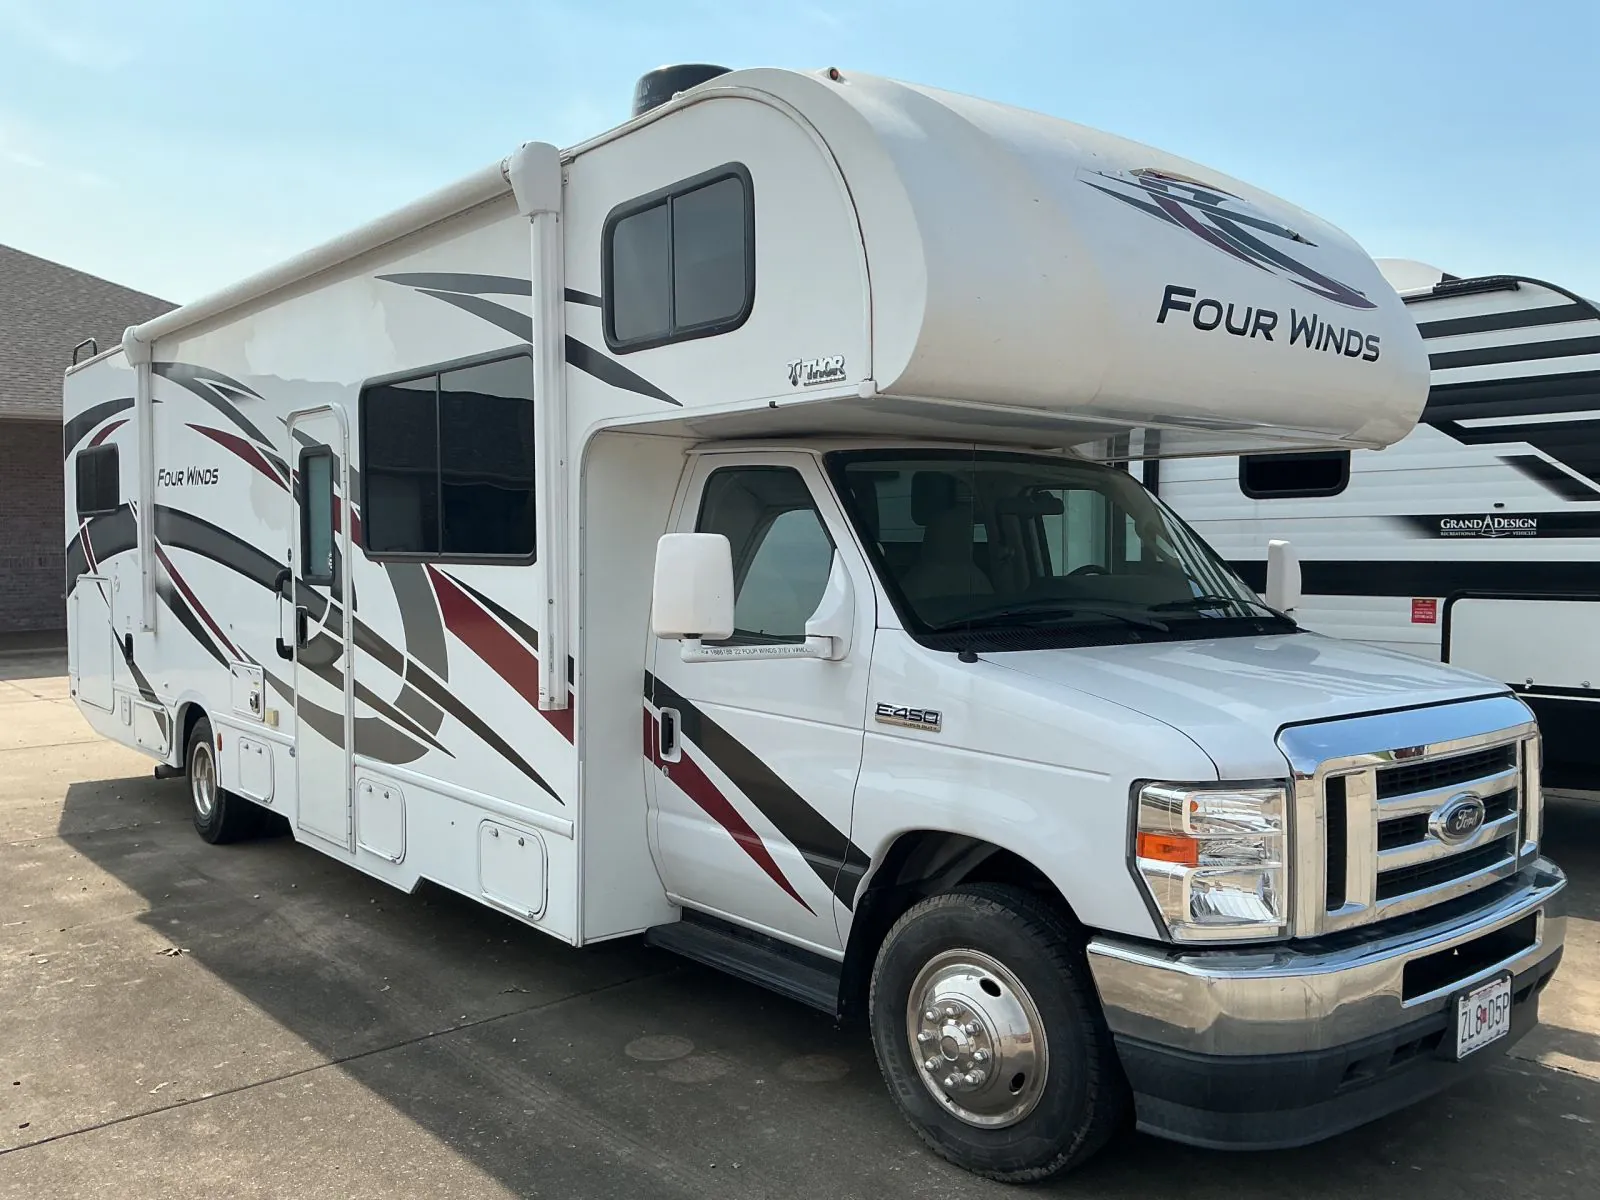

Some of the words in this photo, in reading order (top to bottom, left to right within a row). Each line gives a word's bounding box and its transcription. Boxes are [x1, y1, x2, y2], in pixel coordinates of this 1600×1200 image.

[1156, 284, 1279, 342] FOUR
[1289, 308, 1381, 362] WINDS
[803, 355, 845, 380] THOR
[157, 468, 184, 487] FOUR
[186, 466, 219, 486] WINDS
[1440, 518, 1483, 529] GRAND
[1493, 517, 1537, 528] DESIGN
[1455, 808, 1480, 831] Ford
